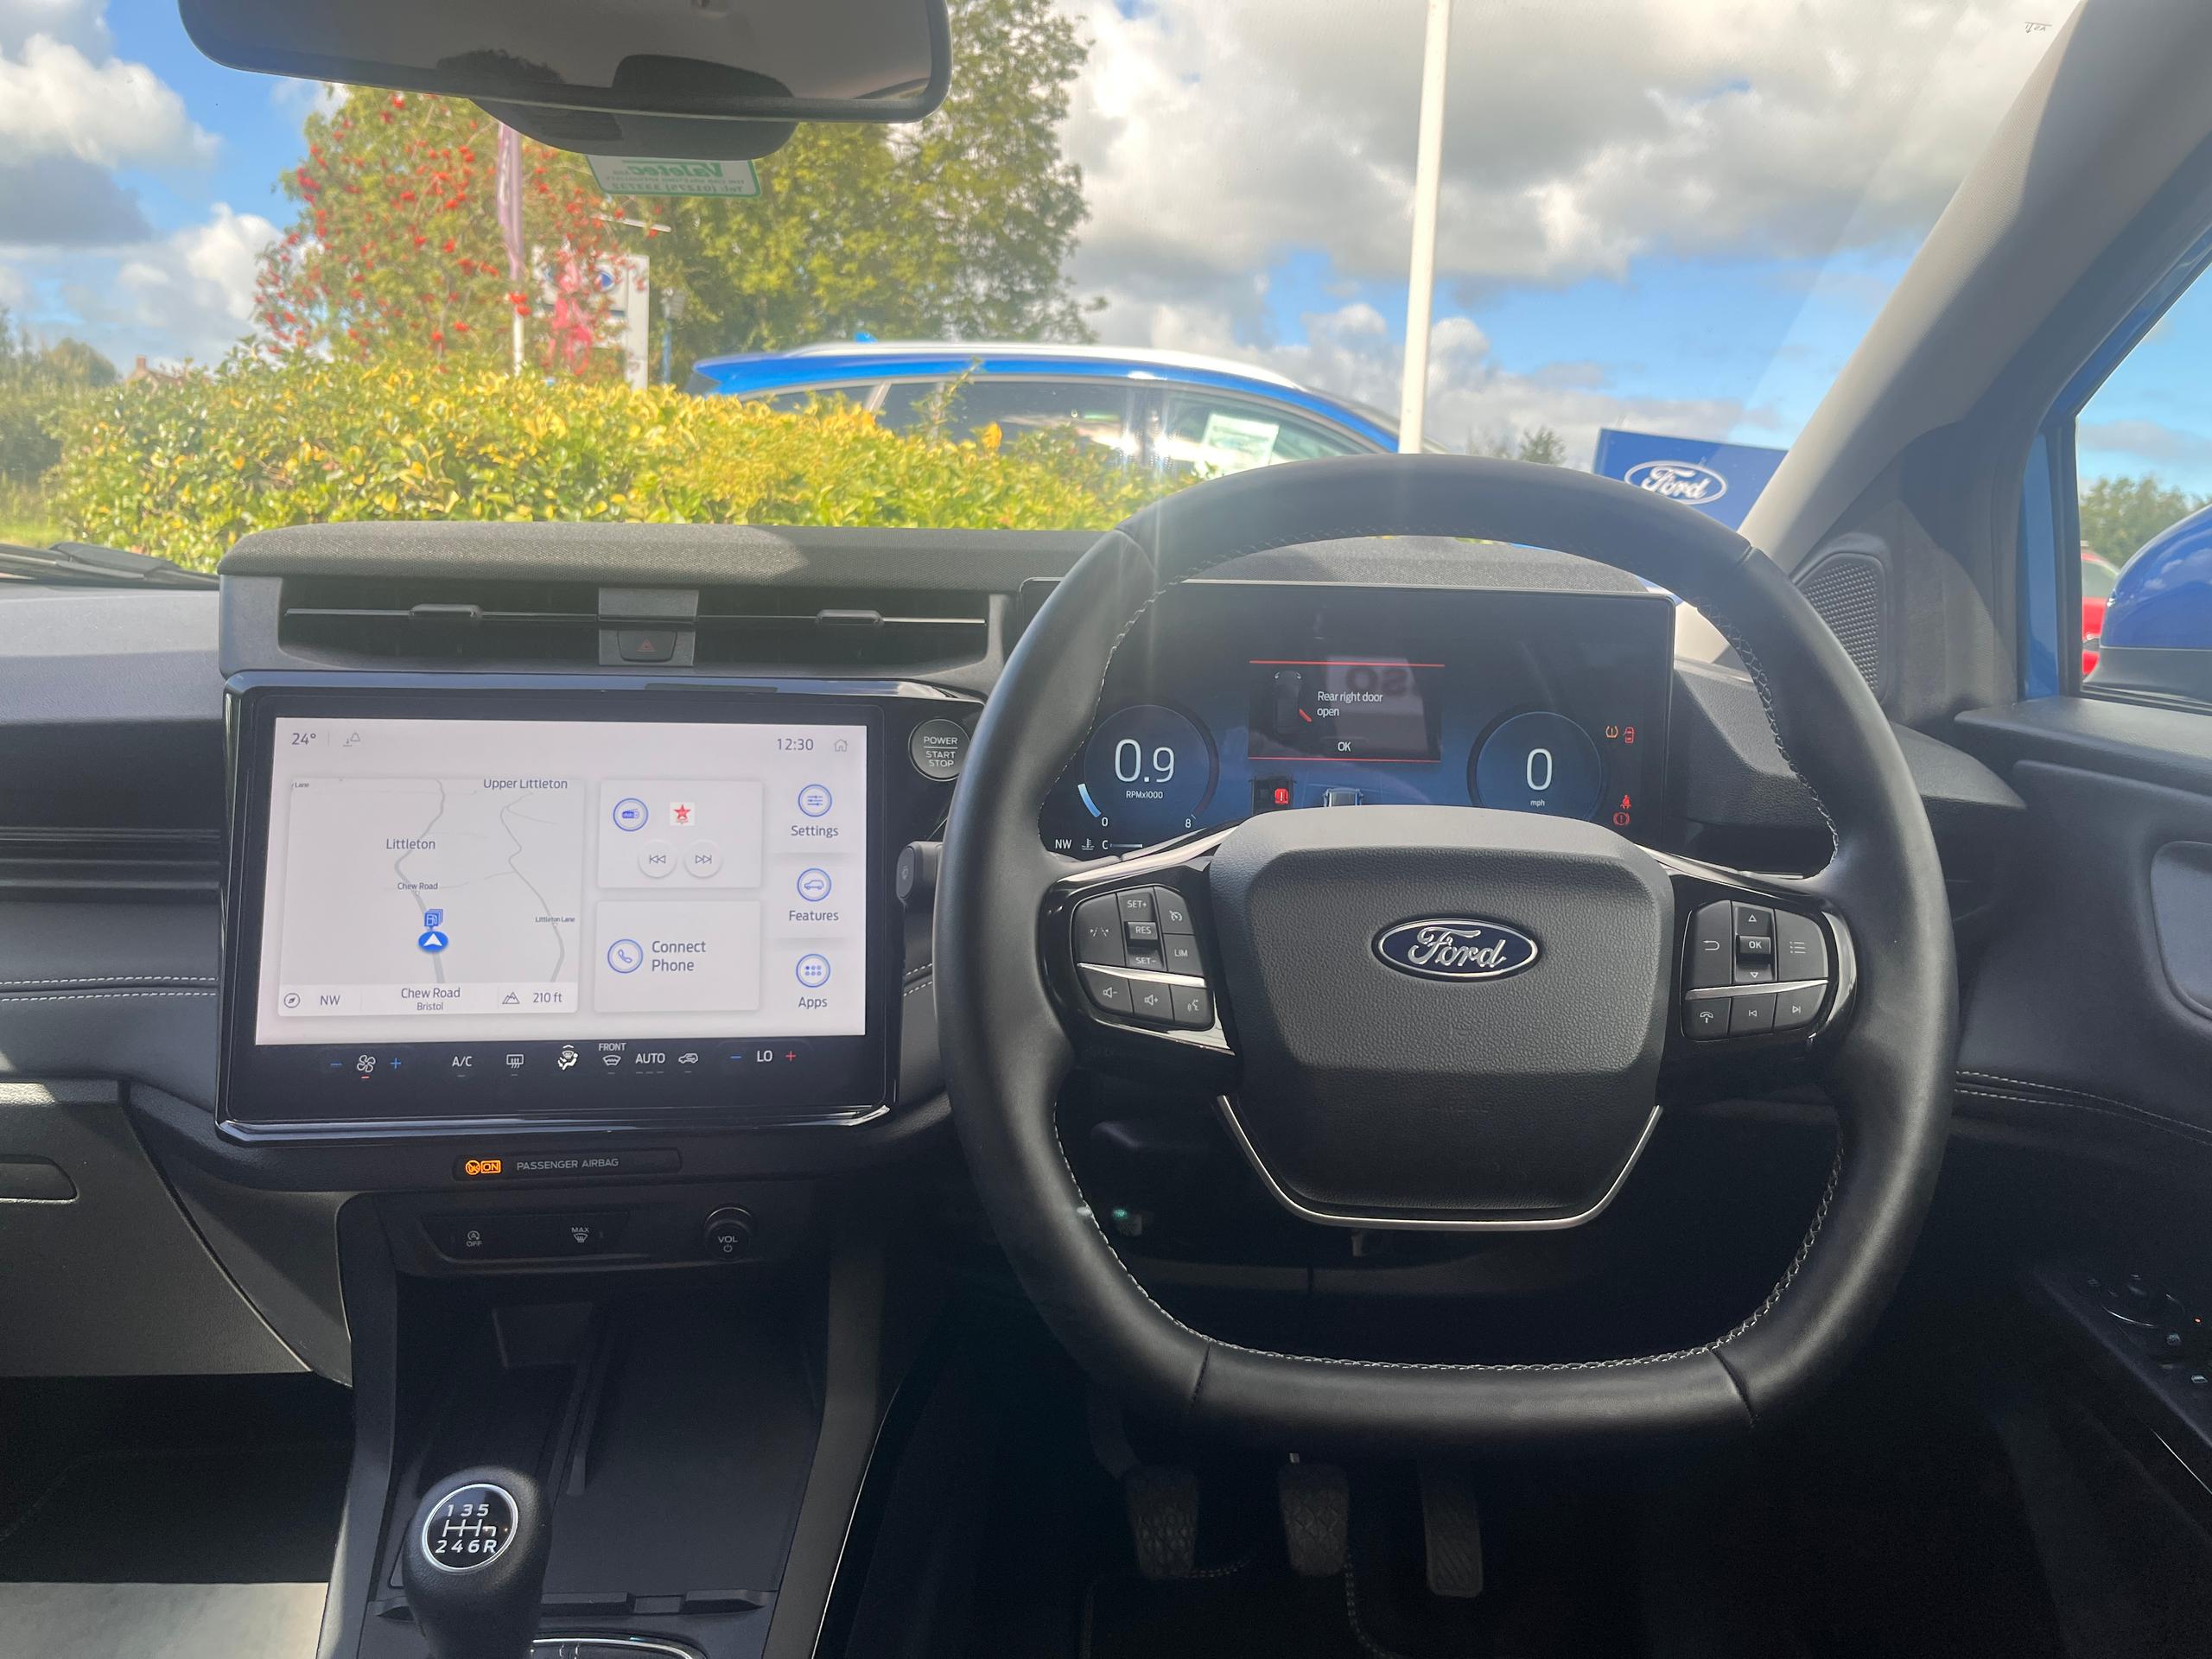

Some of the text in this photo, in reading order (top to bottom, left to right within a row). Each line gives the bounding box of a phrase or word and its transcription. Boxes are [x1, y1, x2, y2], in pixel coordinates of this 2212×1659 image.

[1641, 466, 1713, 499] Ford
[1317, 691, 1383, 703] Rear right door
[1317, 708, 1340, 718] open
[776, 738, 814, 752] 12:30
[923, 736, 958, 745] POWER
[1338, 741, 1351, 752] OK
[925, 750, 956, 759] START
[1114, 738, 1176, 783] 0.9
[1525, 748, 1554, 791] 0
[483, 779, 568, 790] Upper Littleton
[1126, 790, 1164, 800] RPMx1000
[1530, 799, 1546, 808] mph
[1101, 817, 1109, 827] 0
[1185, 818, 1192, 829] 8
[791, 824, 839, 837] Settings
[385, 839, 436, 850] Littleton
[1054, 839, 1073, 849] NW
[397, 882, 418, 891] Chew
[789, 910, 840, 922] Features
[1135, 926, 1152, 935] RES
[652, 940, 707, 954] Connect
[1408, 926, 1508, 968] Ford
[1748, 940, 1763, 950] OK
[652, 960, 695, 972] Phone
[401, 988, 461, 999] Chew Road
[533, 992, 563, 1003] 210 ft
[320, 995, 340, 1006] NW
[416, 1001, 444, 1011] Bristol
[798, 997, 829, 1010] Apps
[599, 1042, 626, 1052] FRONT
[452, 1055, 473, 1067] A/C
[635, 1052, 666, 1065] AUTO
[757, 1050, 773, 1063] LO
[483, 1158, 620, 1171] ON PASSENGER AIRBAG
[717, 1236, 739, 1244] VOL
